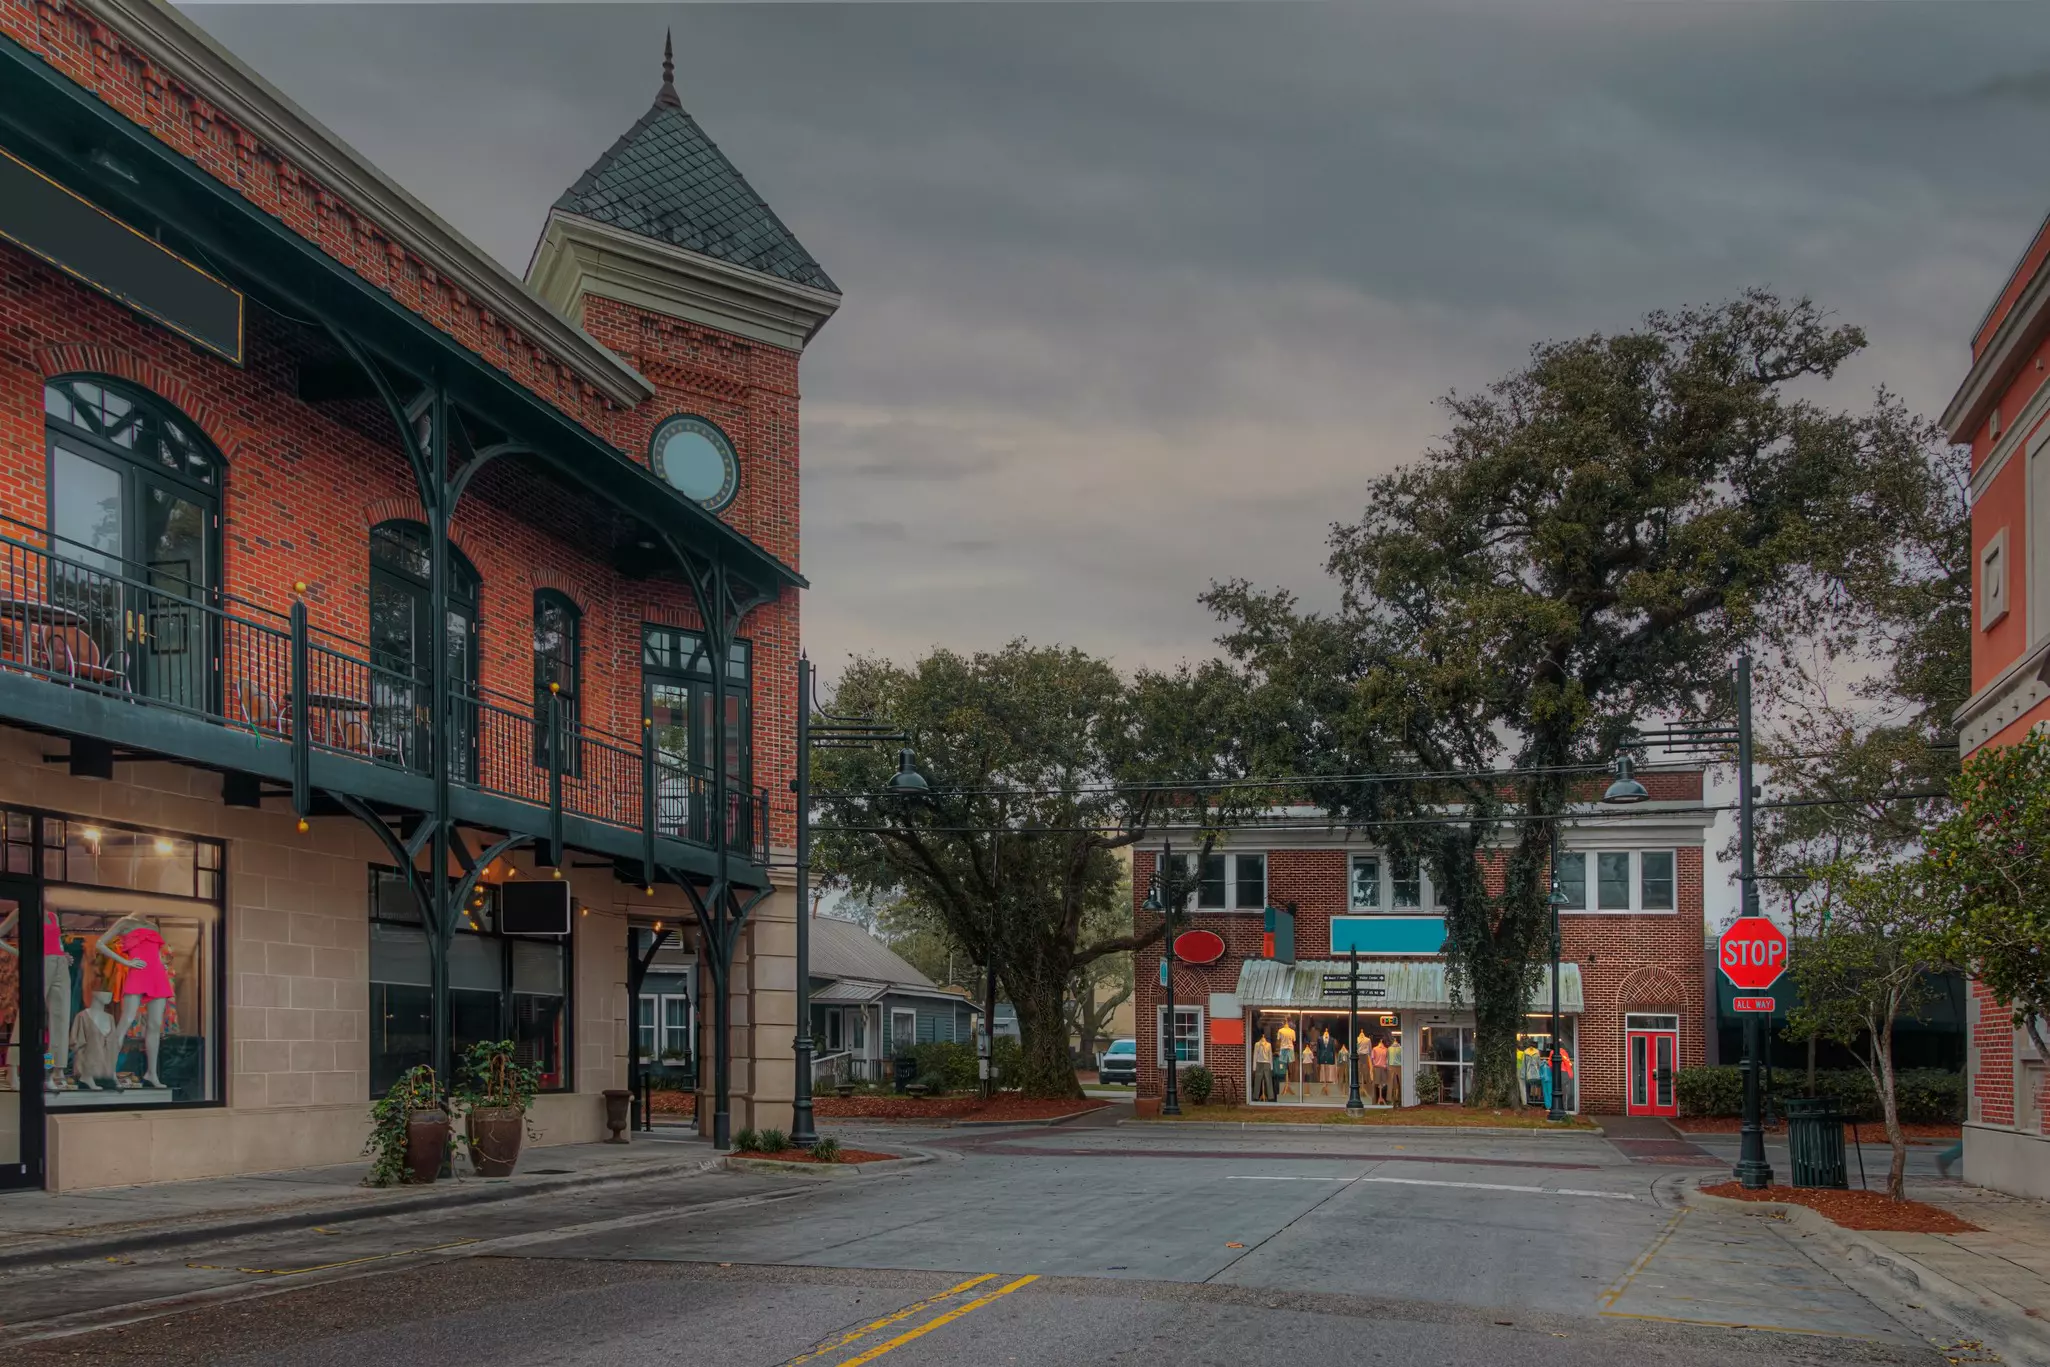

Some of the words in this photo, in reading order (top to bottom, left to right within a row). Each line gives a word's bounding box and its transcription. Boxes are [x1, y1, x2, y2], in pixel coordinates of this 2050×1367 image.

[1724, 940, 1782, 966] STOP
[1737, 1000, 1751, 1009] ALL
[1756, 1000, 1771, 1009] WAY
